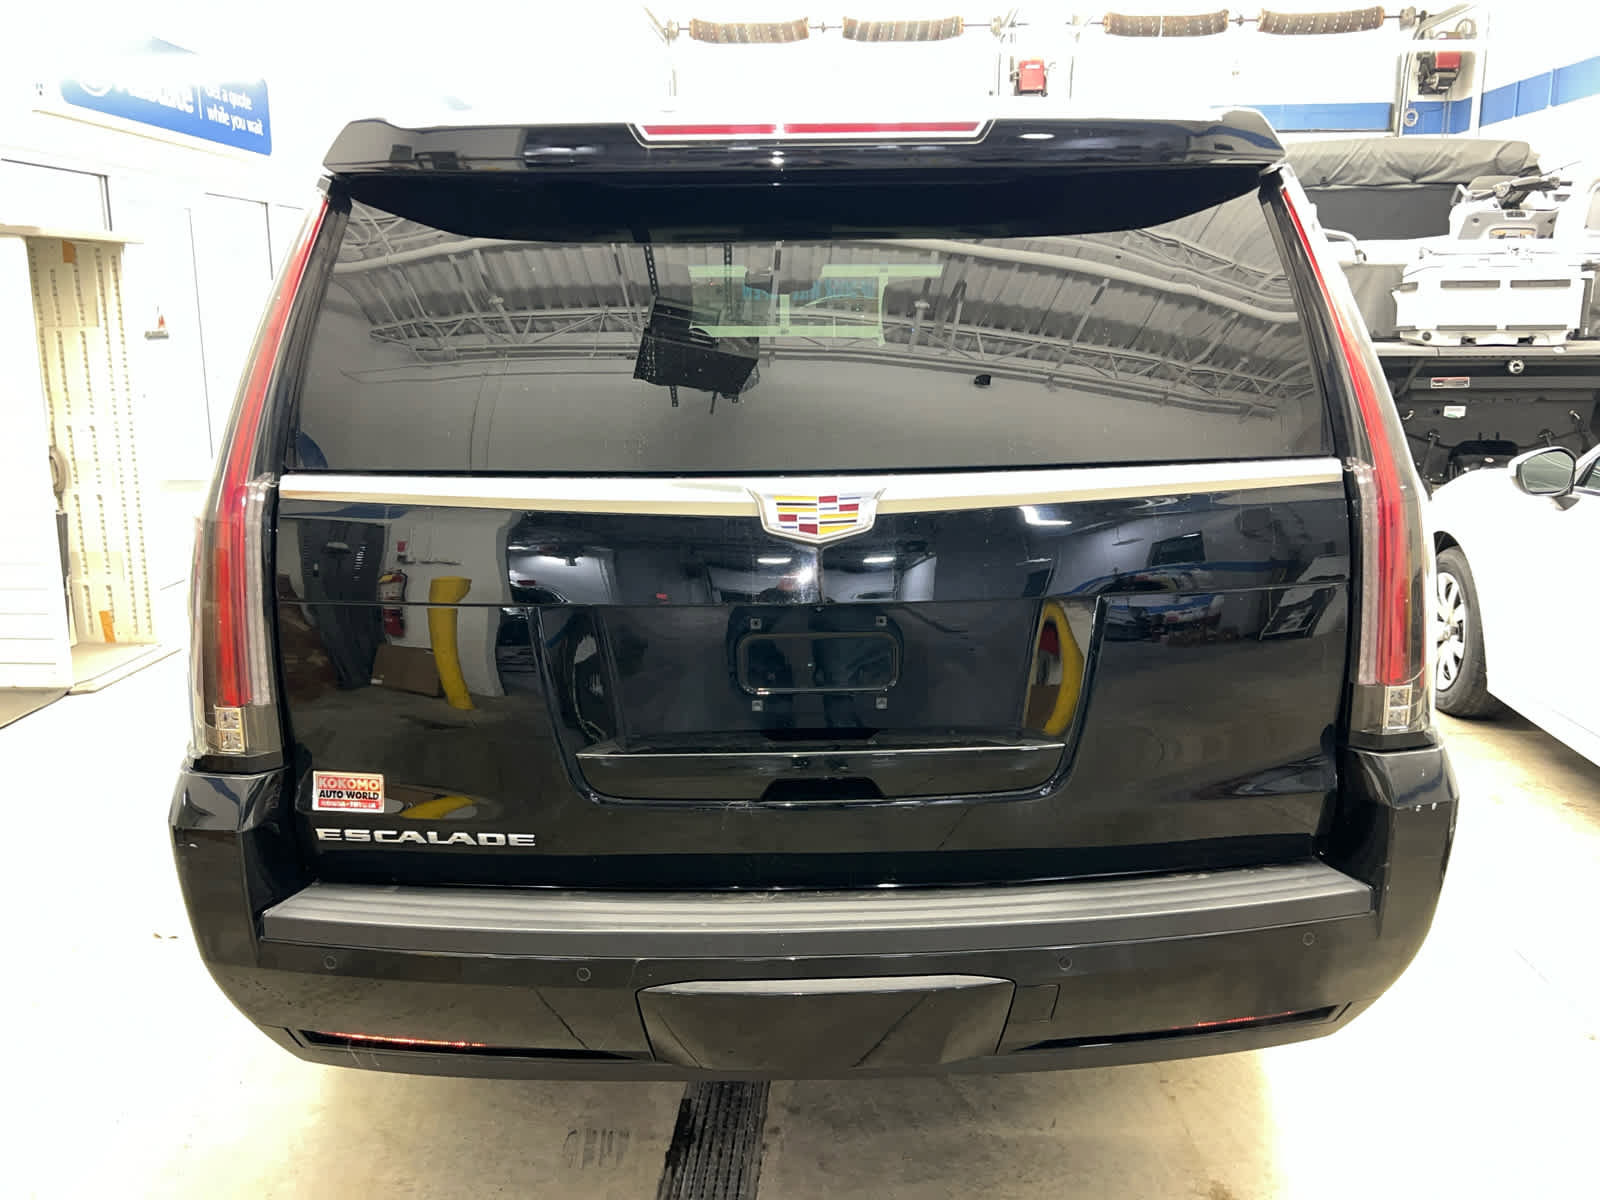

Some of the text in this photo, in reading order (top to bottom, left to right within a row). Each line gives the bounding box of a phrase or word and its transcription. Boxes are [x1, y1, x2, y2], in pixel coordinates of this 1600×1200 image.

[222, 89, 229, 104] a
[229, 90, 253, 110] quote
[207, 103, 264, 136] while you wait
[319, 776, 380, 791] KOKOMO
[319, 789, 380, 800] AUTO WORLD
[315, 827, 536, 847] ESCALADE
